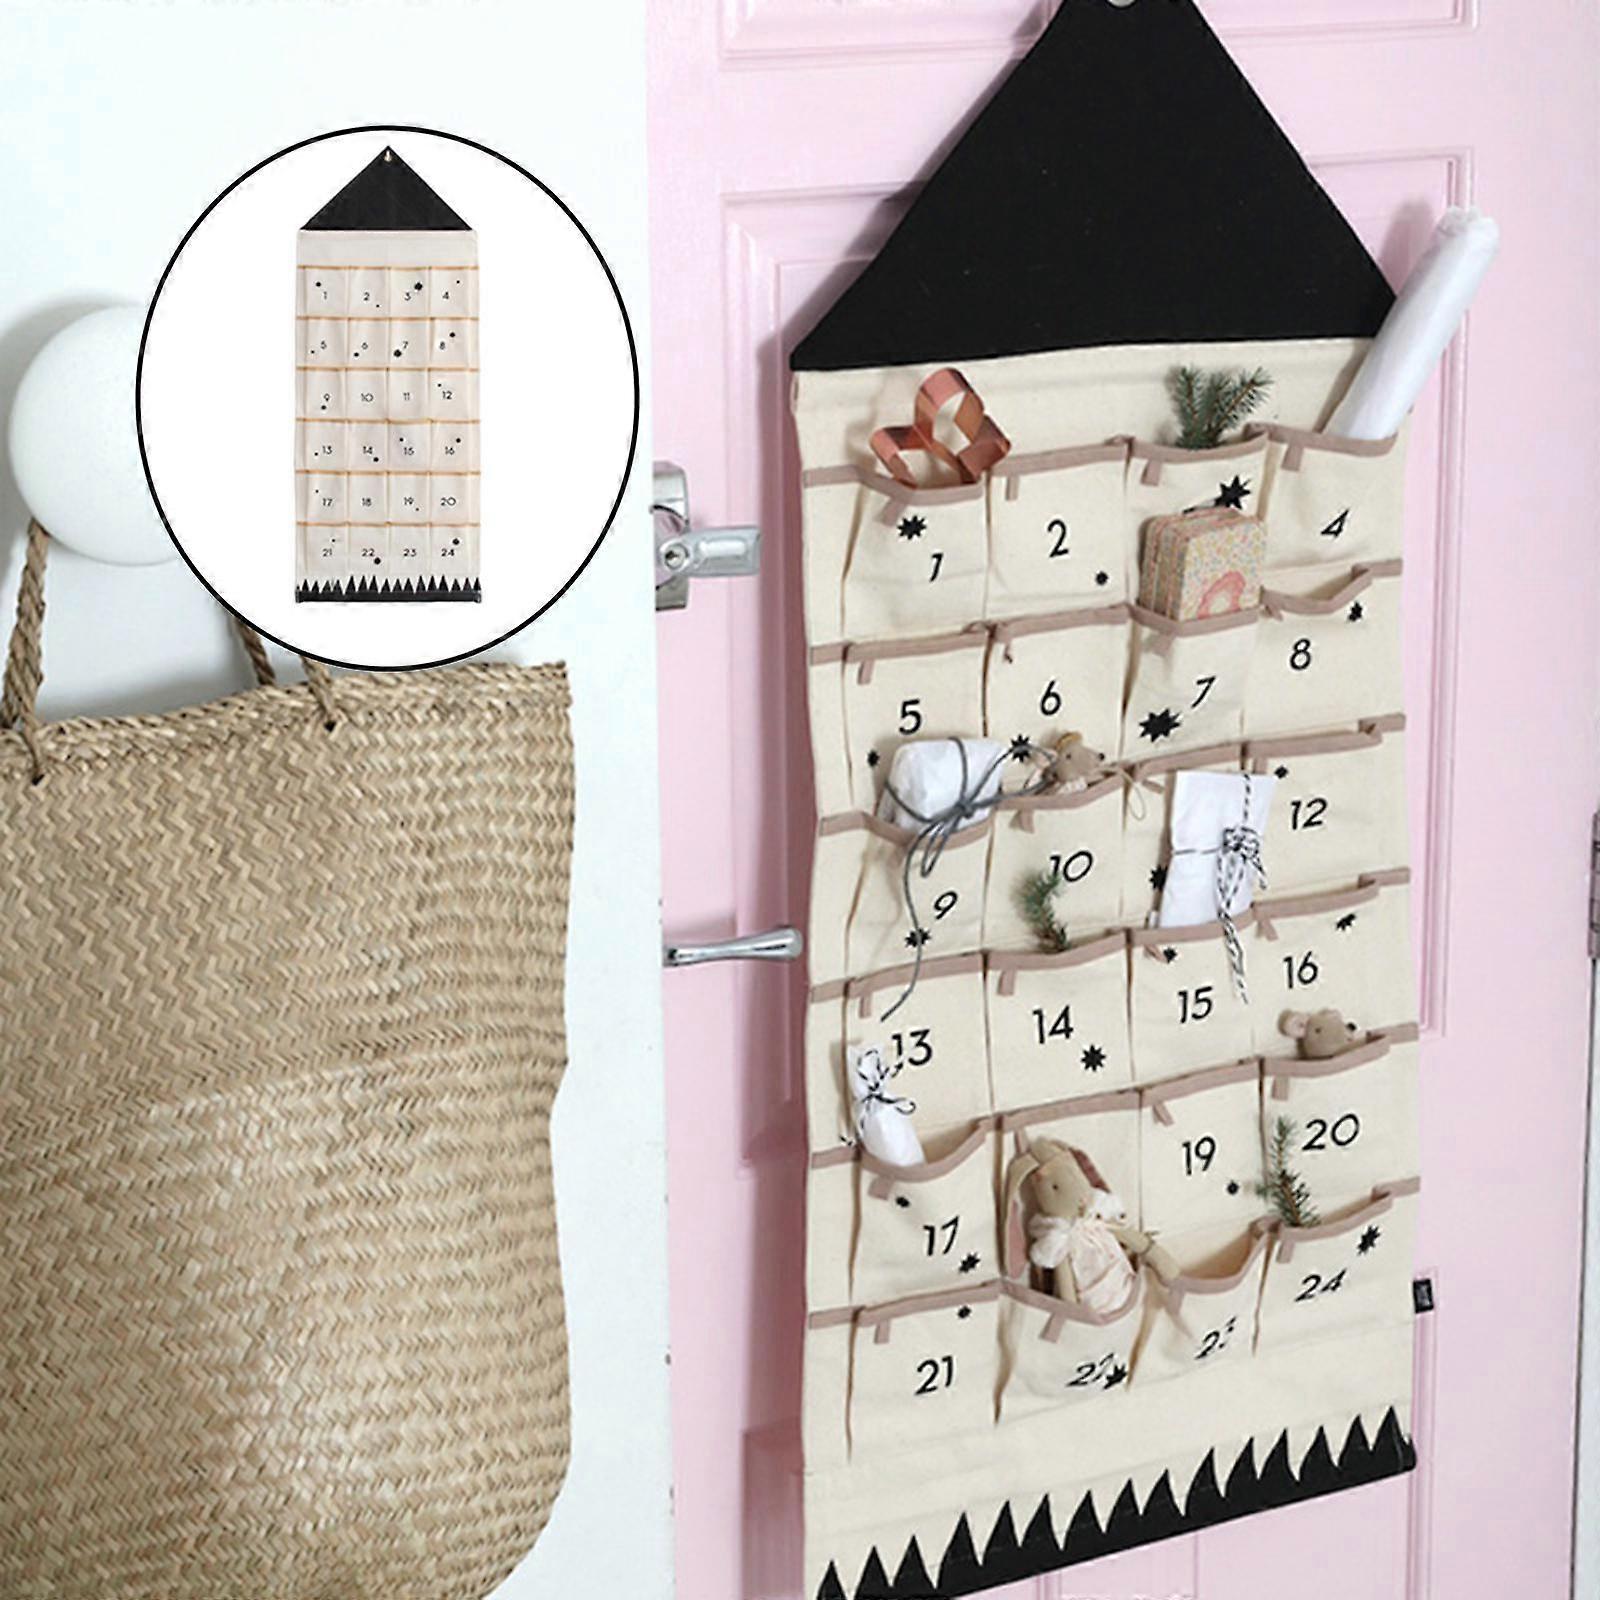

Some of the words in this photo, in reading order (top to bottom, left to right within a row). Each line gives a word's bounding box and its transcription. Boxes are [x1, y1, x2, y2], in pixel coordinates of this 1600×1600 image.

[323, 291, 328, 299] 1
[363, 292, 370, 301] 2
[404, 292, 411, 301] 3
[441, 291, 449, 299] 4
[320, 341, 327, 349] 5
[402, 341, 409, 349] 7
[439, 342, 446, 350] 8
[323, 393, 330, 402] 9
[360, 393, 373, 402] 10
[403, 392, 411, 400] 11
[442, 391, 453, 399] 12
[322, 446, 332, 454] 13
[362, 446, 373, 454] 14
[403, 447, 414, 455] 15
[444, 446, 455, 455] 16
[322, 498, 332, 506] 17
[361, 498, 371, 506] 18
[403, 497, 414, 505] 19
[440, 497, 456, 506] 20
[1320, 509, 1349, 538] 4
[1047, 519, 1069, 558] 2
[361, 548, 375, 557] 22
[403, 549, 416, 557] 23
[440, 548, 454, 557] 24
[930, 552, 944, 582] 1
[1289, 638, 1312, 671] 8
[1191, 676, 1216, 708] 7
[1040, 680, 1062, 716] 6
[899, 699, 921, 735] 5
[1291, 797, 1328, 831] 12
[1050, 851, 1093, 882] 10
[933, 890, 958, 920] 9
[1284, 951, 1318, 988] 16
[1177, 985, 1213, 1024] 15
[1032, 1005, 1074, 1045] 14
[892, 1029, 932, 1068] 13
[1301, 1113, 1360, 1151] 20
[1182, 1136, 1216, 1176] 19
[922, 1215, 959, 1257] 17
[1295, 1269, 1346, 1302] 24
[915, 1355, 953, 1396] 21
